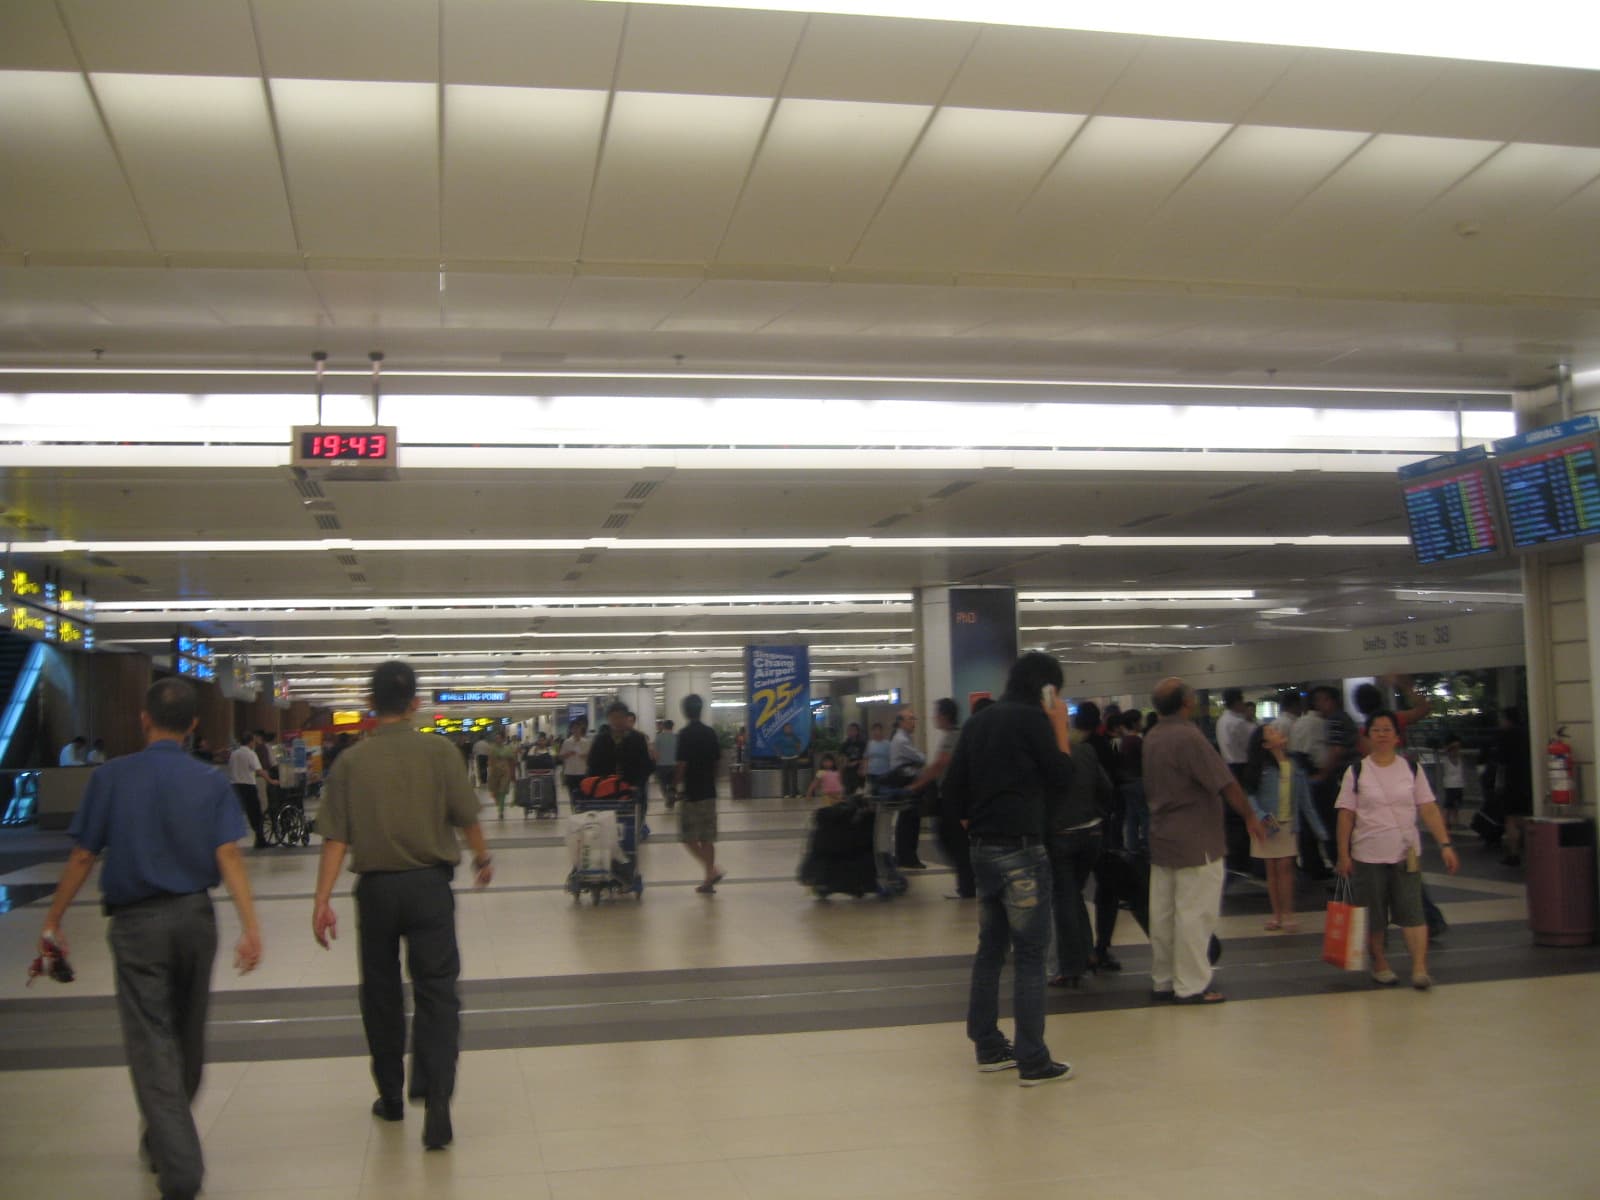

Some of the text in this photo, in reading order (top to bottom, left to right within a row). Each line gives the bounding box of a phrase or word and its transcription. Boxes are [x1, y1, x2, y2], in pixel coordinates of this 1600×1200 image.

[312, 435, 386, 457] 19:43
[754, 667, 796, 680] Airport
[752, 682, 794, 729] 25
